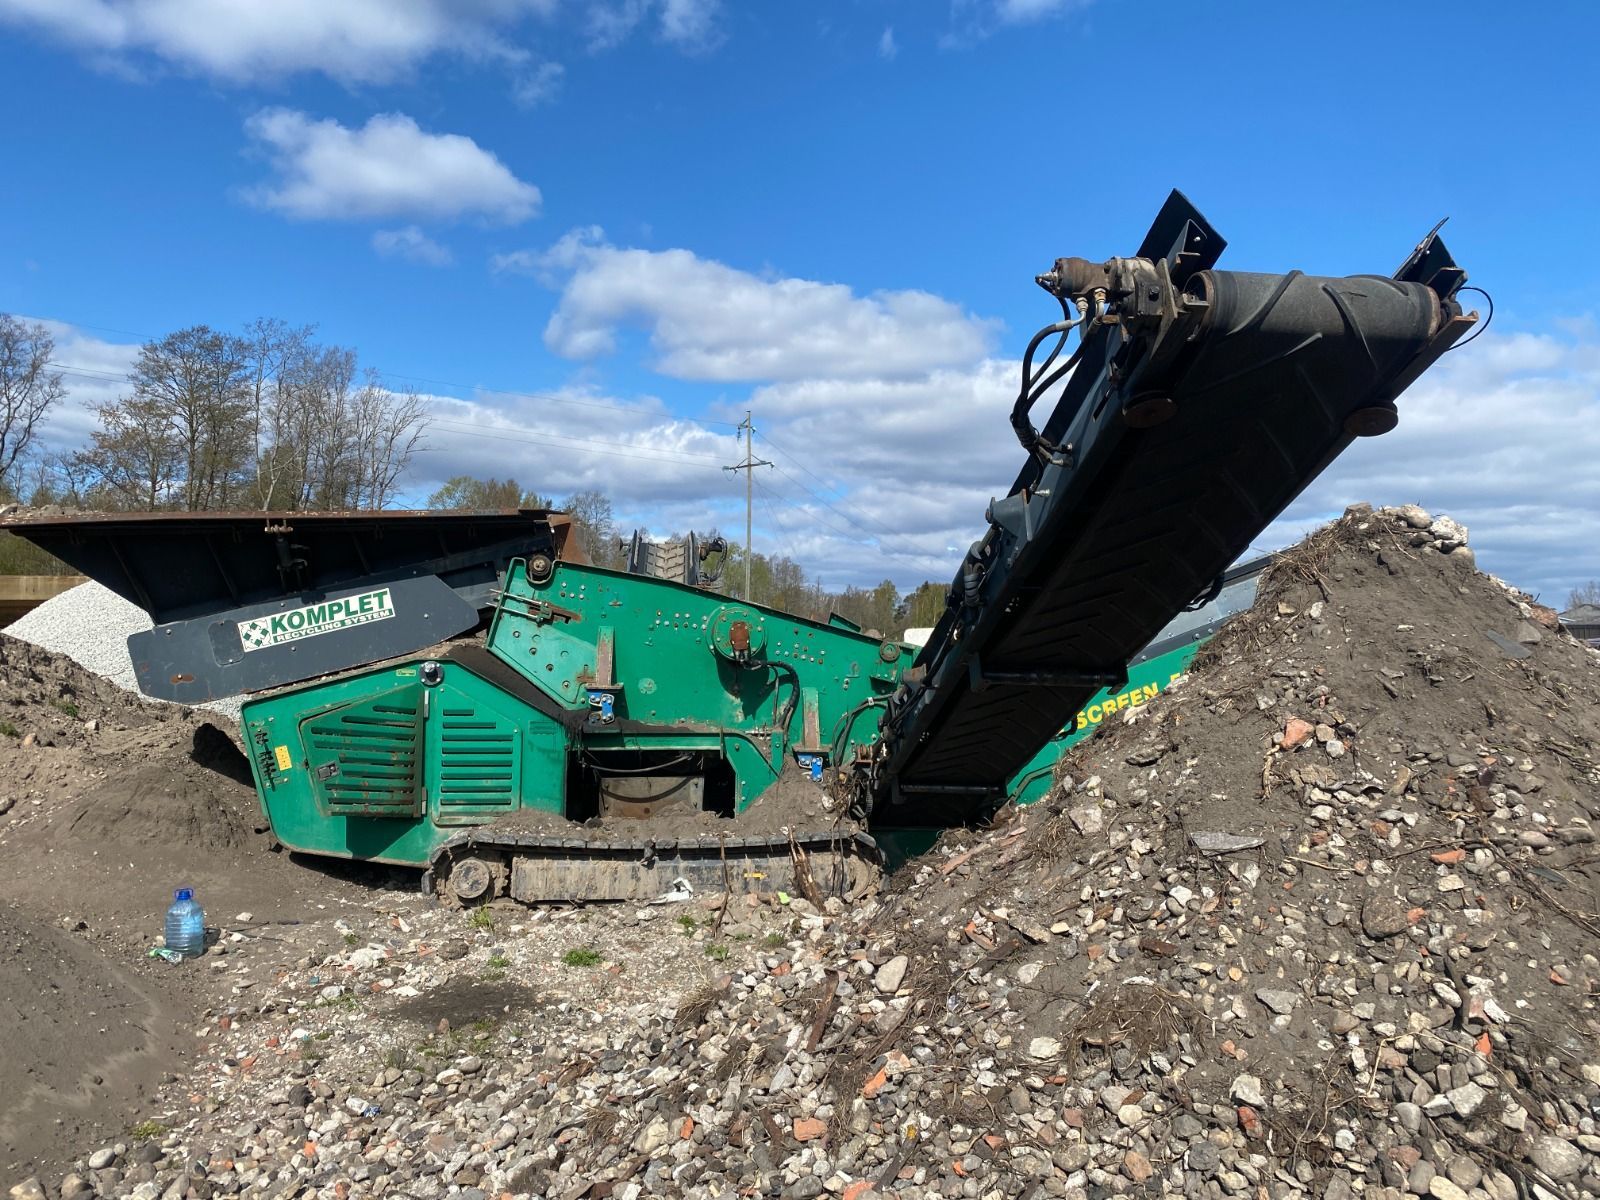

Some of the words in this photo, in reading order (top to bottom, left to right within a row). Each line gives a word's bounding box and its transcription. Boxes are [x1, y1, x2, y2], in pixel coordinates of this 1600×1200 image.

[271, 590, 388, 634] KOMPLET
[277, 622, 342, 642] RECYCLING
[344, 610, 390, 626] SYSTEM
